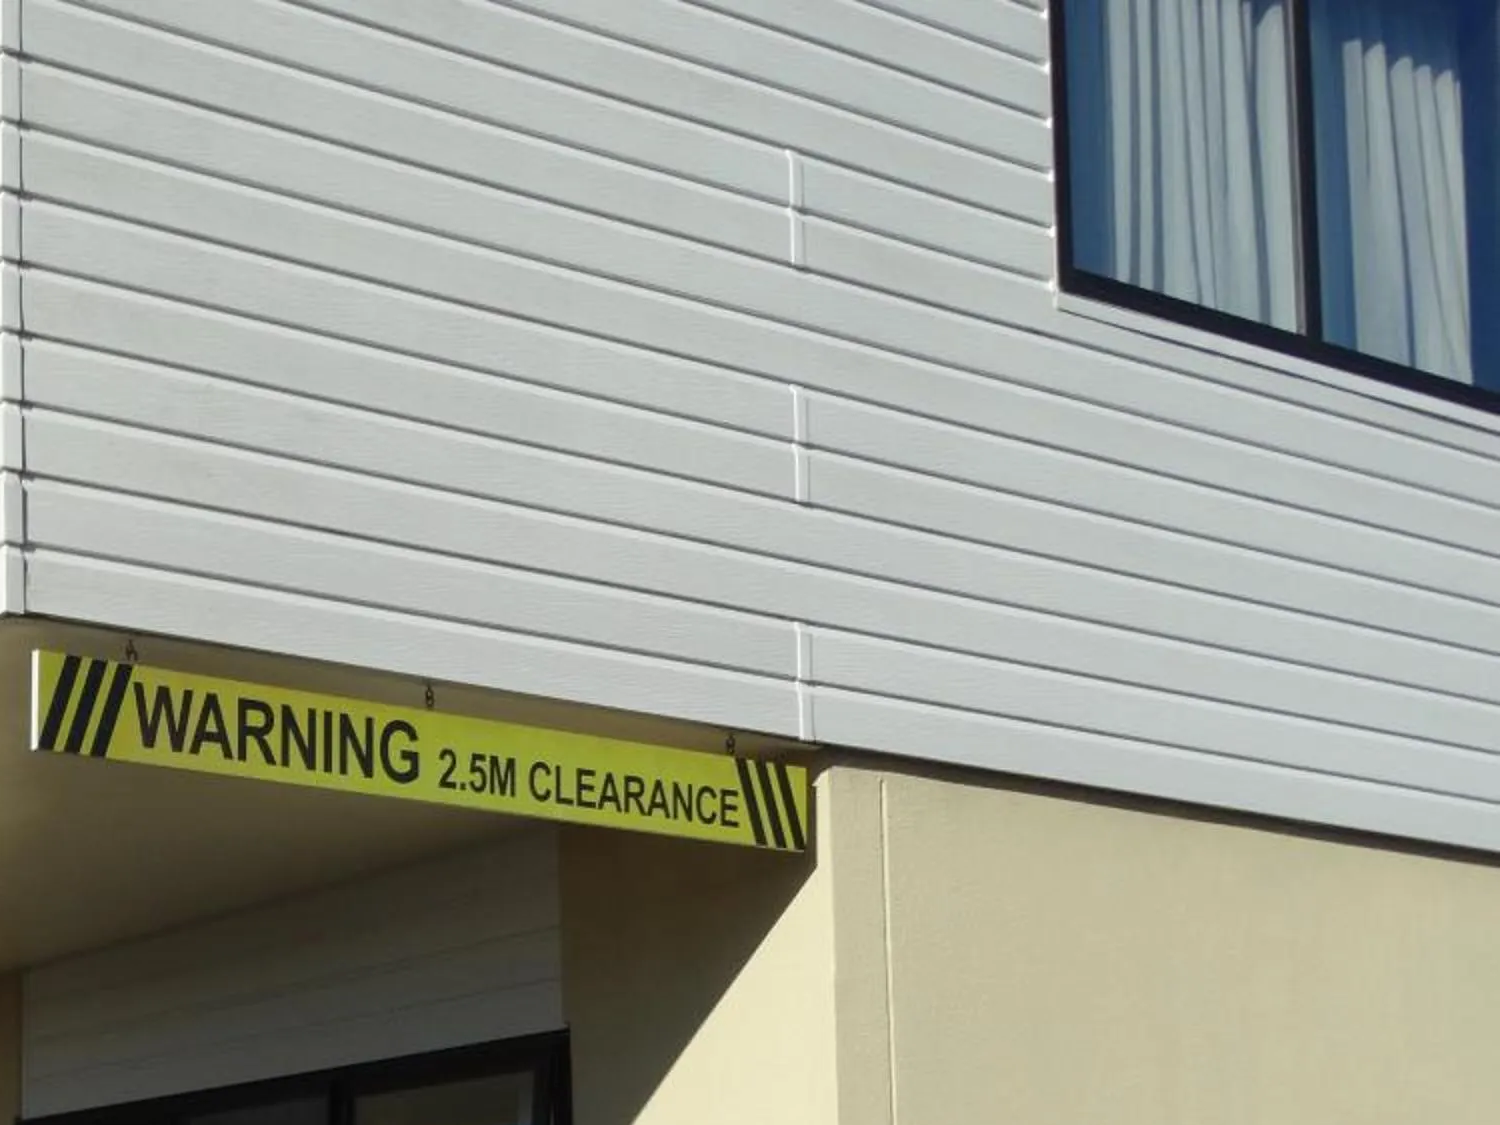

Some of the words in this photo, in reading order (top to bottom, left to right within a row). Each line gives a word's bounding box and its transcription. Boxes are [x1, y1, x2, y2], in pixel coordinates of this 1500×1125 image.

[133, 681, 420, 784] WARNING
[438, 748, 516, 797] 2.5M
[528, 761, 739, 828] CLEARANCE
